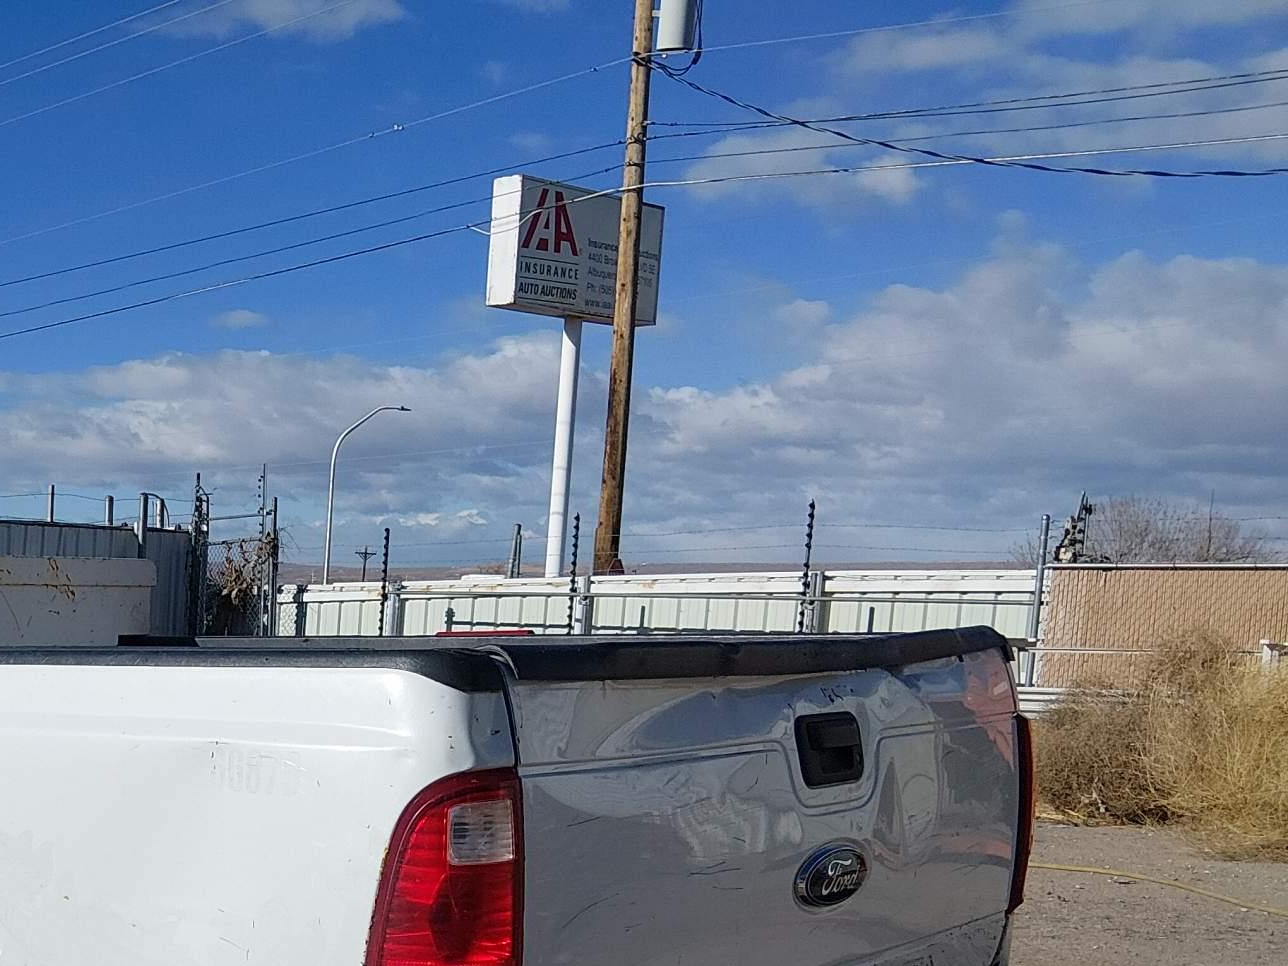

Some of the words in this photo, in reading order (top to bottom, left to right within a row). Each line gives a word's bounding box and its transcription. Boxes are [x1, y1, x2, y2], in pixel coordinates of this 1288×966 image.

[520, 261, 579, 280] INSURANCE
[518, 281, 539, 295] AUTO
[540, 285, 578, 300] AUCTIONS
[821, 858, 861, 896] Ford
